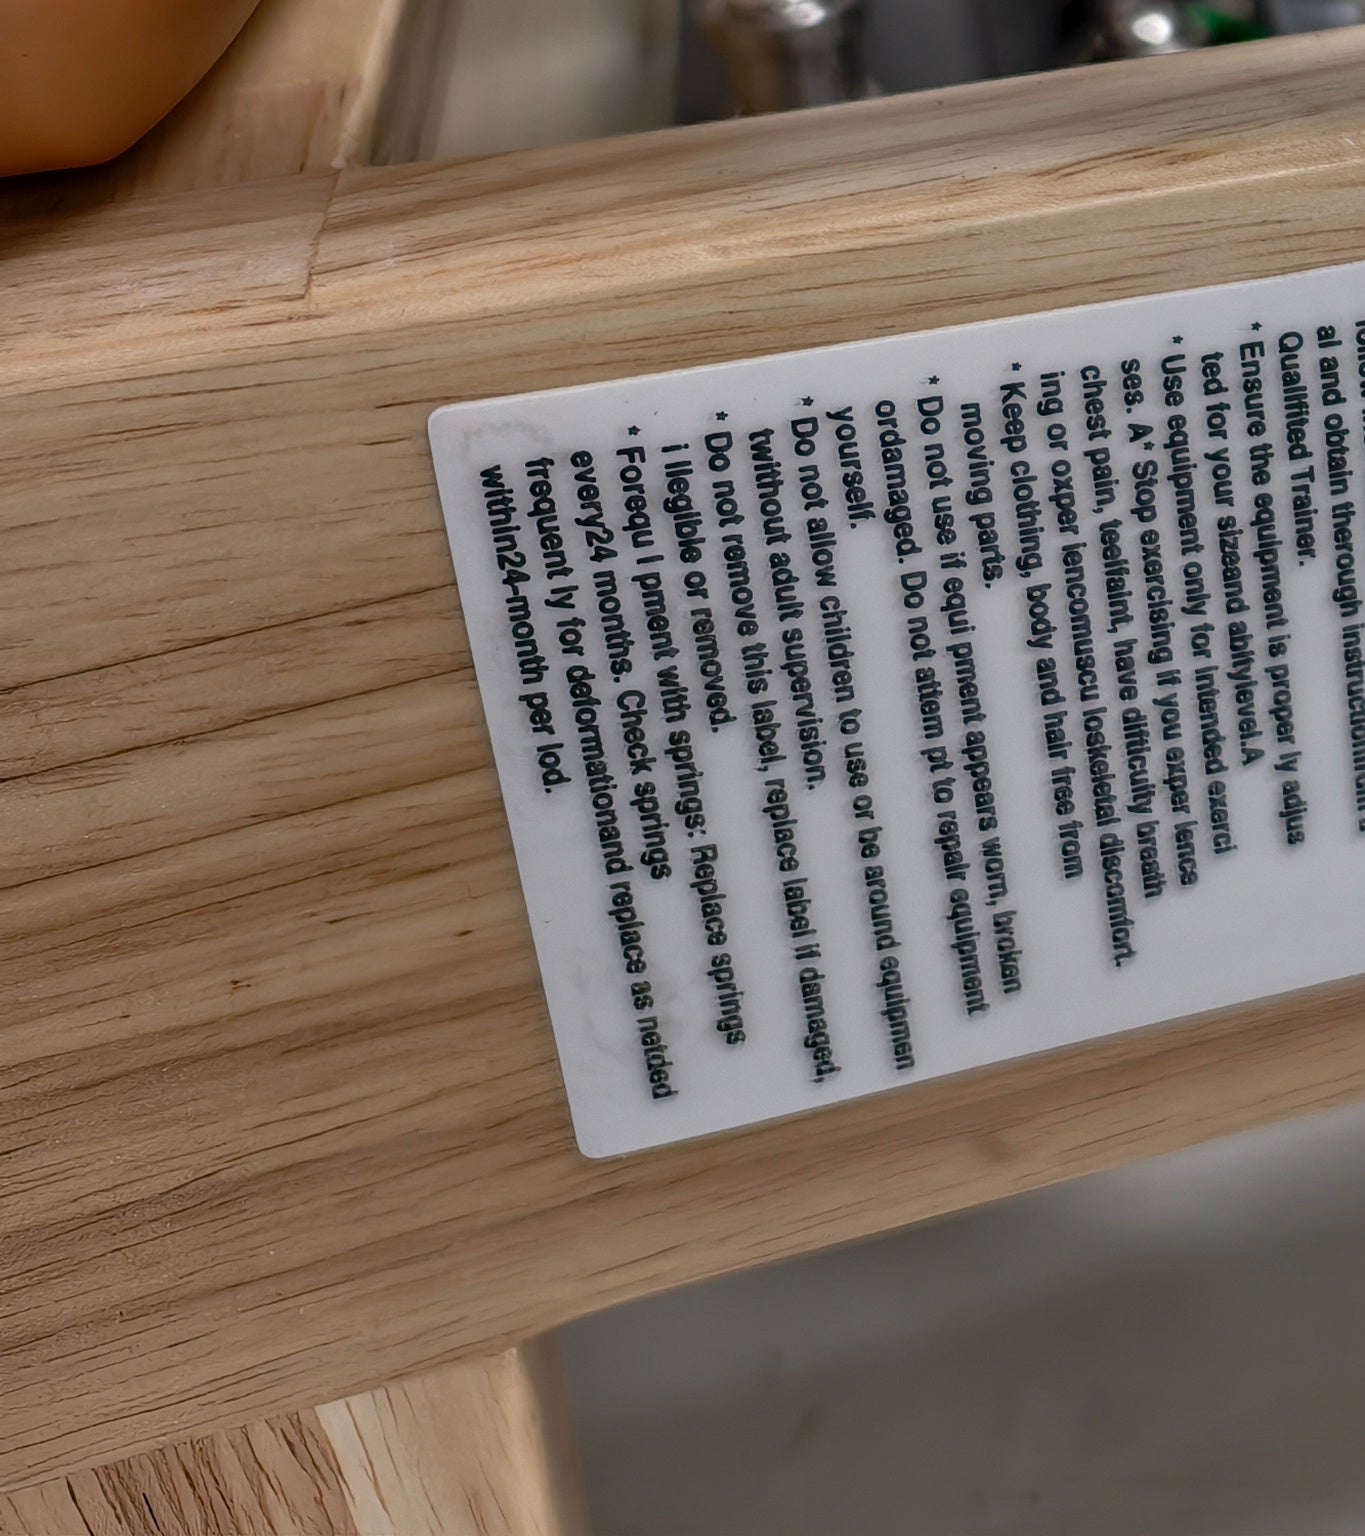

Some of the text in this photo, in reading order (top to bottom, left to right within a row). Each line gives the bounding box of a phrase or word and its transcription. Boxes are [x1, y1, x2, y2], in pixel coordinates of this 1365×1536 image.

[1035, 369, 1066, 417] ing
[1119, 357, 1145, 415] ses.
[1159, 352, 1187, 408] Use
[1199, 350, 1230, 397] ted
[1238, 339, 1267, 438] Ensure
[1317, 355, 1348, 407] and
[789, 415, 820, 457] Do
[915, 394, 944, 436] Do
[1045, 422, 1069, 451] or
[1204, 400, 1232, 440] for
[824, 404, 877, 530] yourself.
[922, 441, 954, 490] not
[1202, 446, 1235, 508] your
[1247, 441, 1275, 487] the
[1322, 412, 1354, 496] obtain
[796, 463, 830, 512] not
[959, 401, 1006, 589] moving parts.
[1128, 458, 1159, 524] Stop
[1161, 413, 1205, 557] equipment
[1289, 463, 1319, 567] Trainer.
[929, 494, 958, 546] use
[805, 516, 838, 587] allow
[938, 550, 968, 570] if
[1248, 491, 1289, 631] equipment
[682, 569, 710, 600] or
[767, 551, 805, 623] adult
[899, 569, 928, 609] Do
[1138, 527, 1176, 665] exercising
[1179, 560, 1212, 616] only
[591, 568, 636, 684] months.
[818, 594, 855, 704] children
[905, 615, 937, 662] not
[998, 380, 1084, 880] Keep clothing, body and hair free from
[1078, 364, 1167, 899] chest pain, have breath
[1188, 621, 1215, 659] for
[1266, 633, 1292, 659] is
[655, 663, 692, 724] with
[689, 606, 738, 734] removed.
[1154, 668, 1183, 687] if
[516, 690, 556, 736] per
[523, 455, 574, 581] frequent
[555, 615, 587, 657] for
[606, 880, 647, 975] replace
[629, 979, 654, 1011] as
[615, 688, 657, 777] Check
[777, 626, 827, 791] supervision.
[836, 707, 863, 735] to
[1150, 691, 1183, 741] you
[702, 429, 842, 1084] Do not remove this label, replace label if damaged,
[842, 740, 869, 789] use
[959, 729, 998, 832] appears
[851, 793, 875, 821] or
[930, 775, 957, 804] to
[628, 780, 673, 881] springs
[856, 824, 884, 859] be
[932, 809, 971, 881] repair
[688, 842, 728, 947] Replace
[862, 864, 902, 952] around
[943, 887, 990, 1017] equipment
[704, 951, 747, 1046] springs
